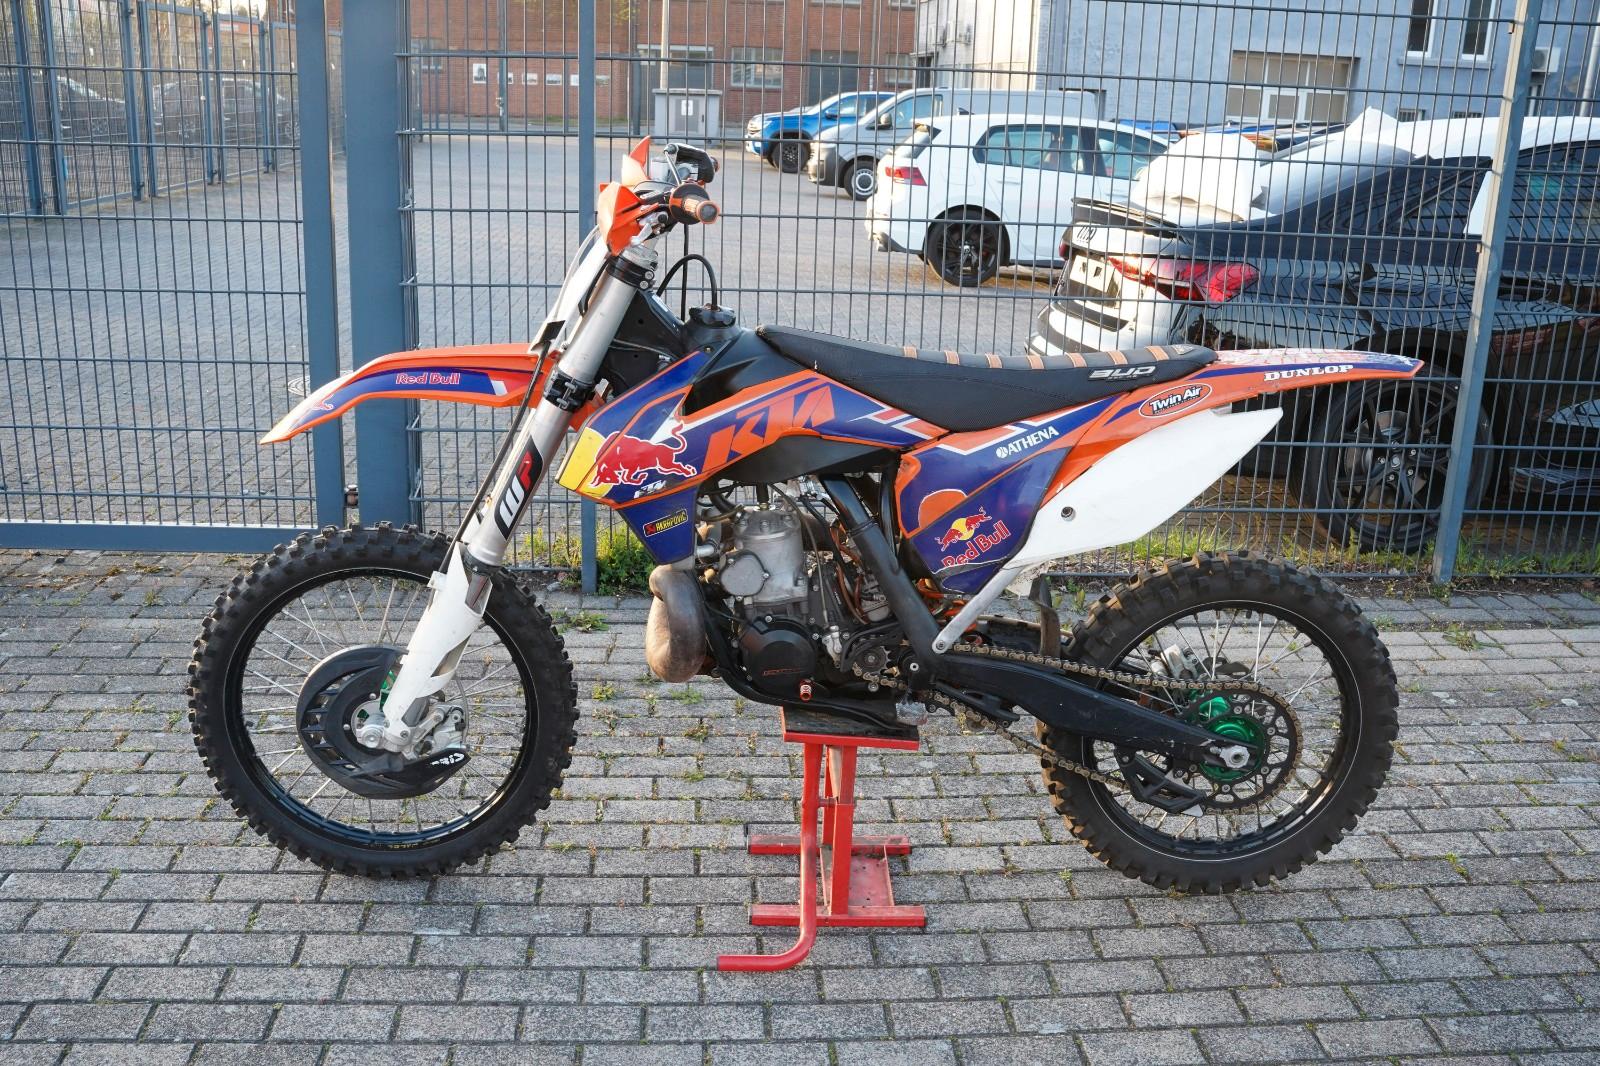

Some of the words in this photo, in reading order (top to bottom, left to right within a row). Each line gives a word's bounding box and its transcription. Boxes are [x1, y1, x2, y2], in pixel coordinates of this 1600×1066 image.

[396, 372, 428, 385] Red
[429, 372, 460, 385] Bull
[1089, 366, 1155, 378] BUD
[1263, 364, 1353, 381] DUNLOP
[1149, 395, 1182, 413] Twin
[1183, 386, 1202, 401] Air
[702, 385, 835, 473] KTM
[1008, 425, 1060, 456] ATHENA
[941, 541, 980, 568] Red
[973, 519, 1012, 553] Bull
